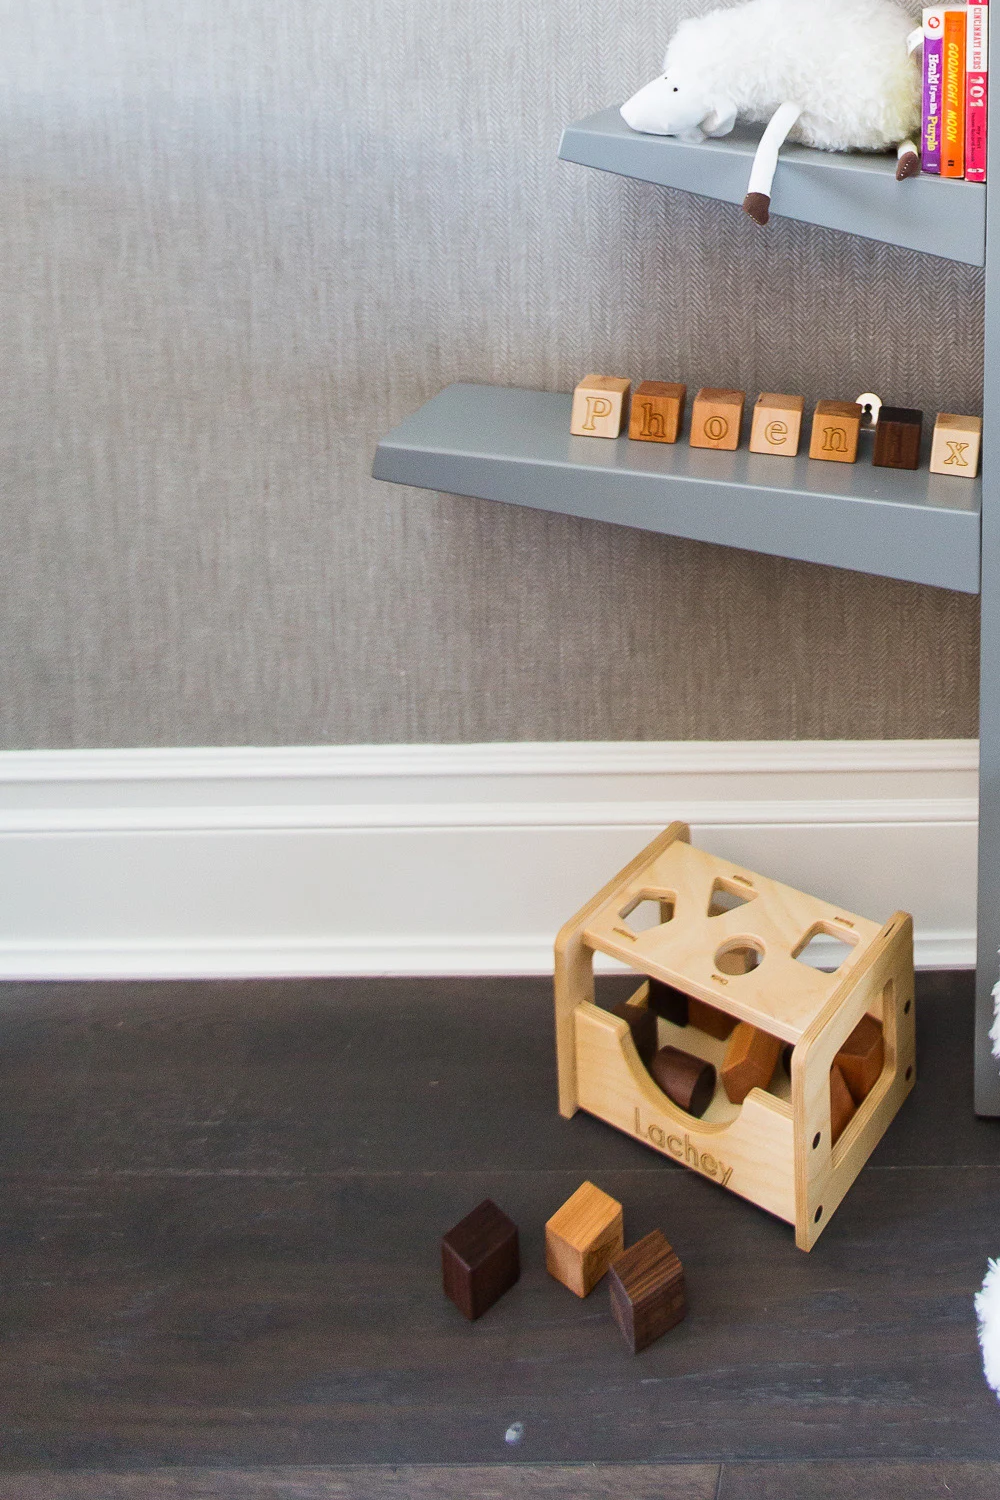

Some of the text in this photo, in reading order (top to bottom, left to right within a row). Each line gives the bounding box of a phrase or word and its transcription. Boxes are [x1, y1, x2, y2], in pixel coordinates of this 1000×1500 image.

[972, 7, 982, 70] CINCINNATI REDS
[947, 42, 959, 107] GOODNIGHT
[969, 76, 985, 107] 101
[925, 115, 938, 152] Purple
[946, 109, 958, 143] MOON
[634, 1106, 734, 1187] Lachey
